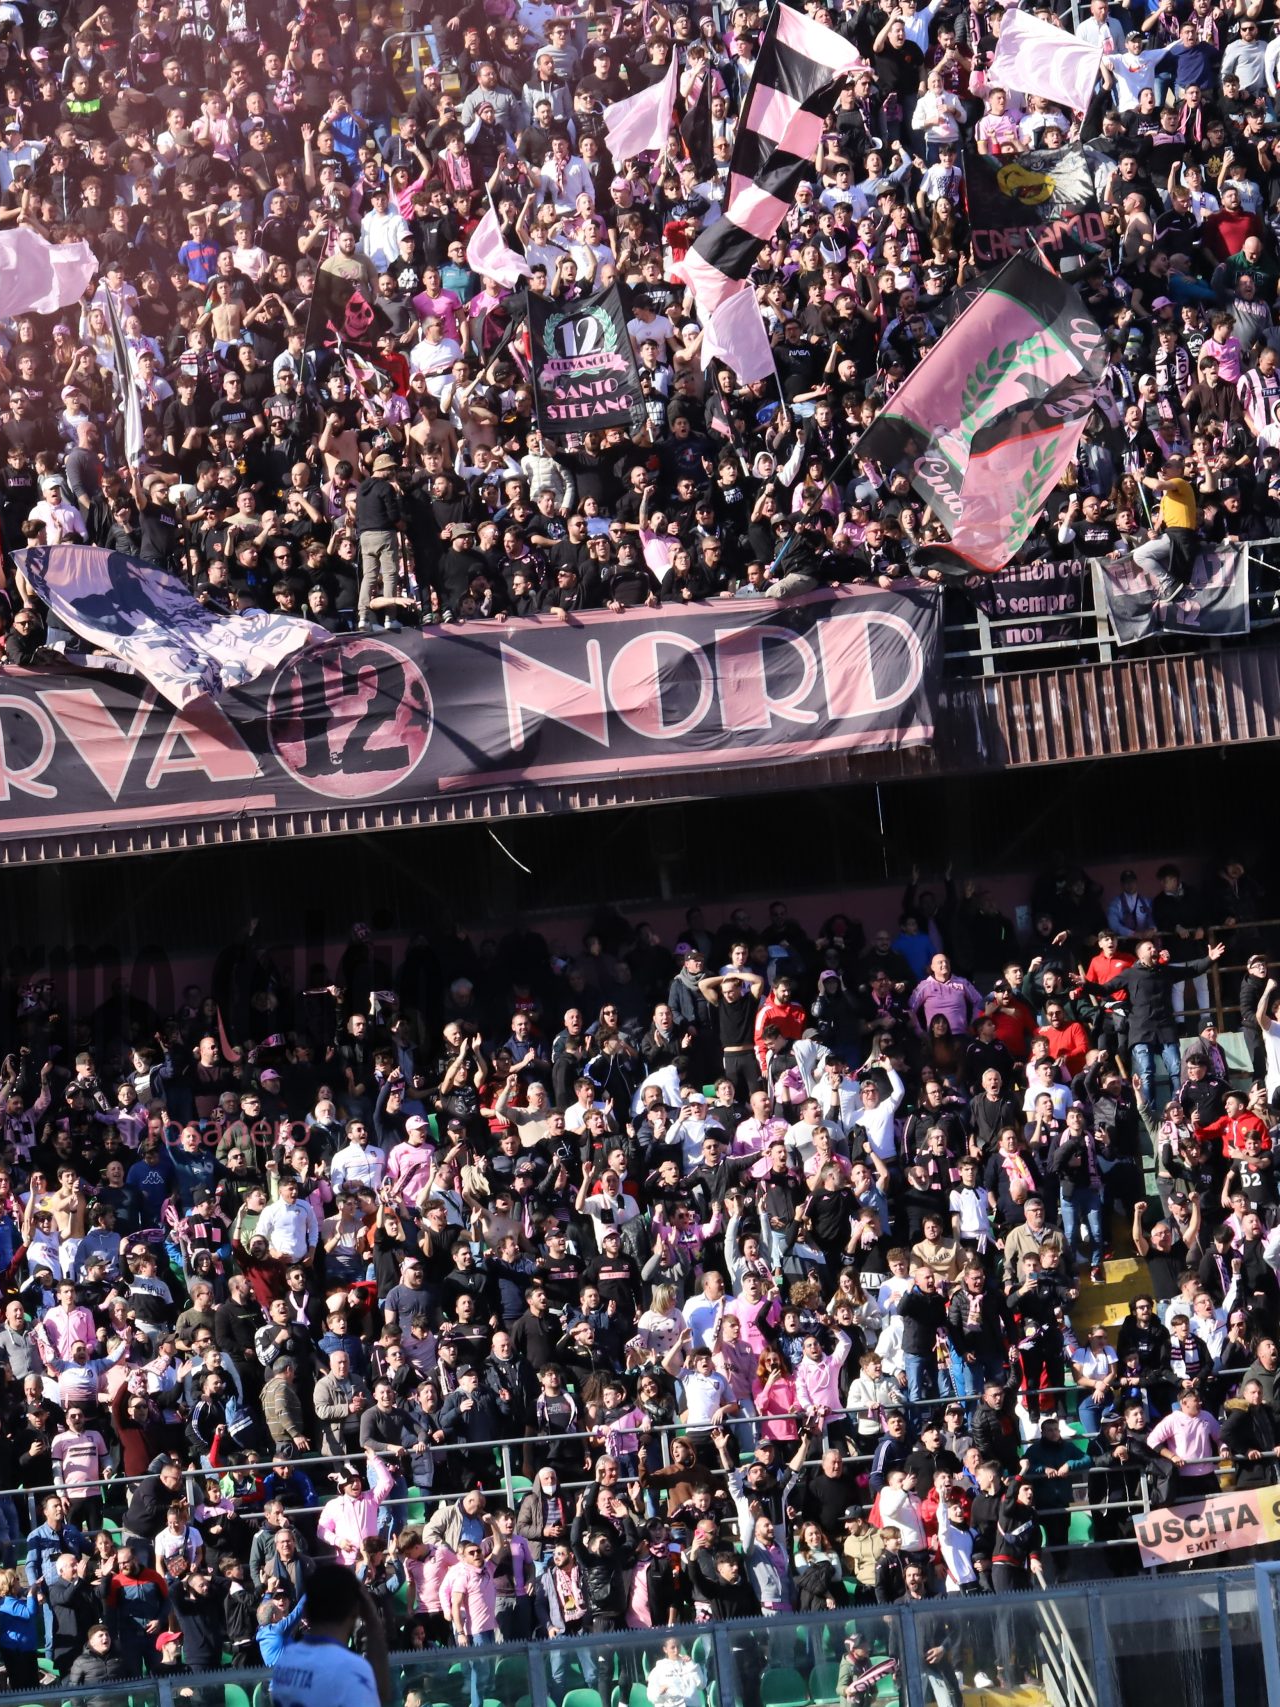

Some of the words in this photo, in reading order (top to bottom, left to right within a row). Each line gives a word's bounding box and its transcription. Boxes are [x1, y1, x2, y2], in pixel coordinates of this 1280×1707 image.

[557, 315, 602, 358] 12
[554, 377, 619, 400] SANTO
[546, 394, 634, 420] STEFANO
[1009, 593, 1076, 616] sempre
[1005, 624, 1043, 644] noi
[498, 609, 925, 752] NORD
[298, 645, 412, 777] 12
[1241, 1172, 1262, 1188] D2
[1138, 1503, 1260, 1548] USCITA
[1186, 1539, 1218, 1554] EXIT
